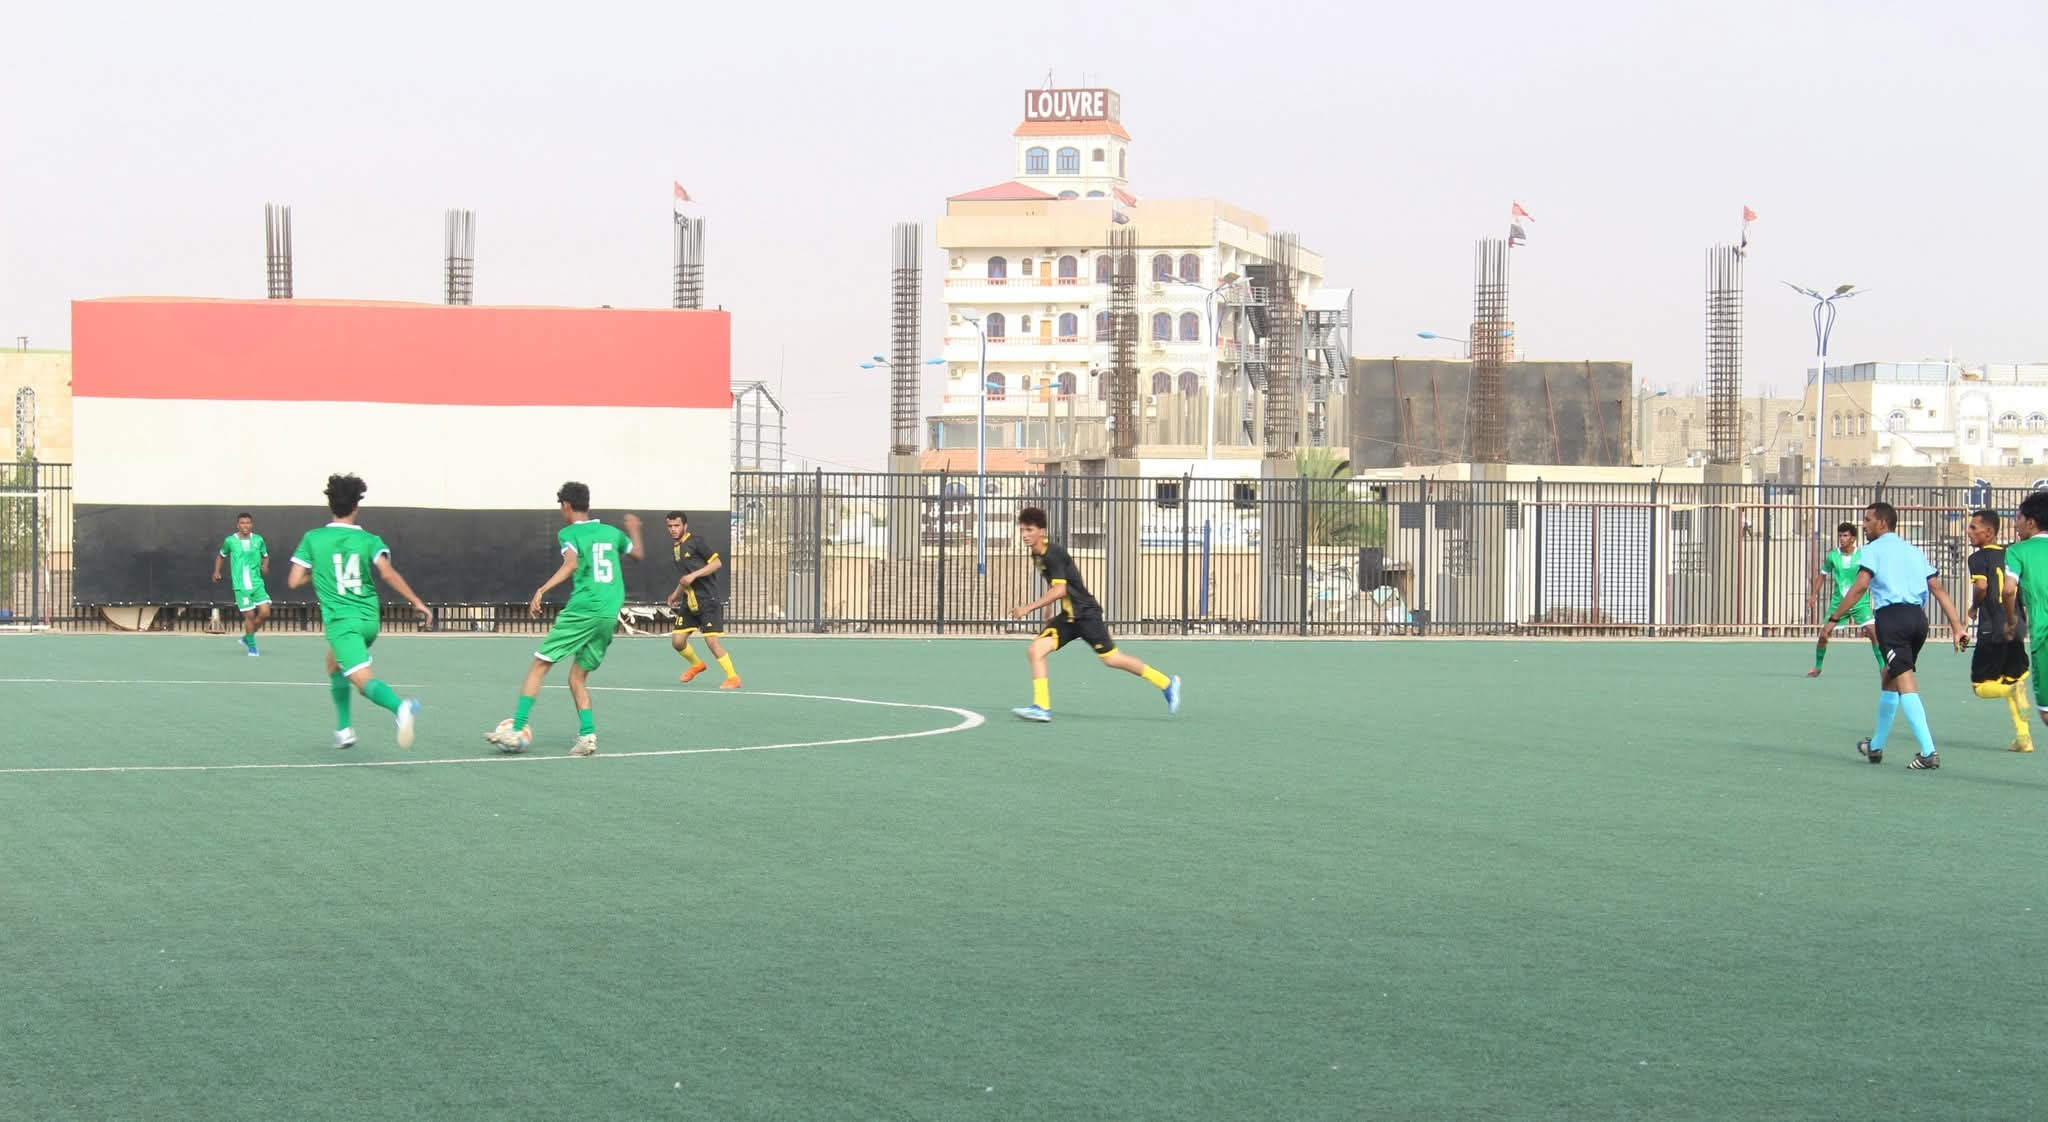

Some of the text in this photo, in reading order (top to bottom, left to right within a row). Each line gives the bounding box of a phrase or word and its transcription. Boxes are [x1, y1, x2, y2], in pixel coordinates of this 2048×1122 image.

[1027, 91, 1104, 118] LOUVRE
[333, 553, 362, 595] 14
[592, 542, 613, 583] 15
